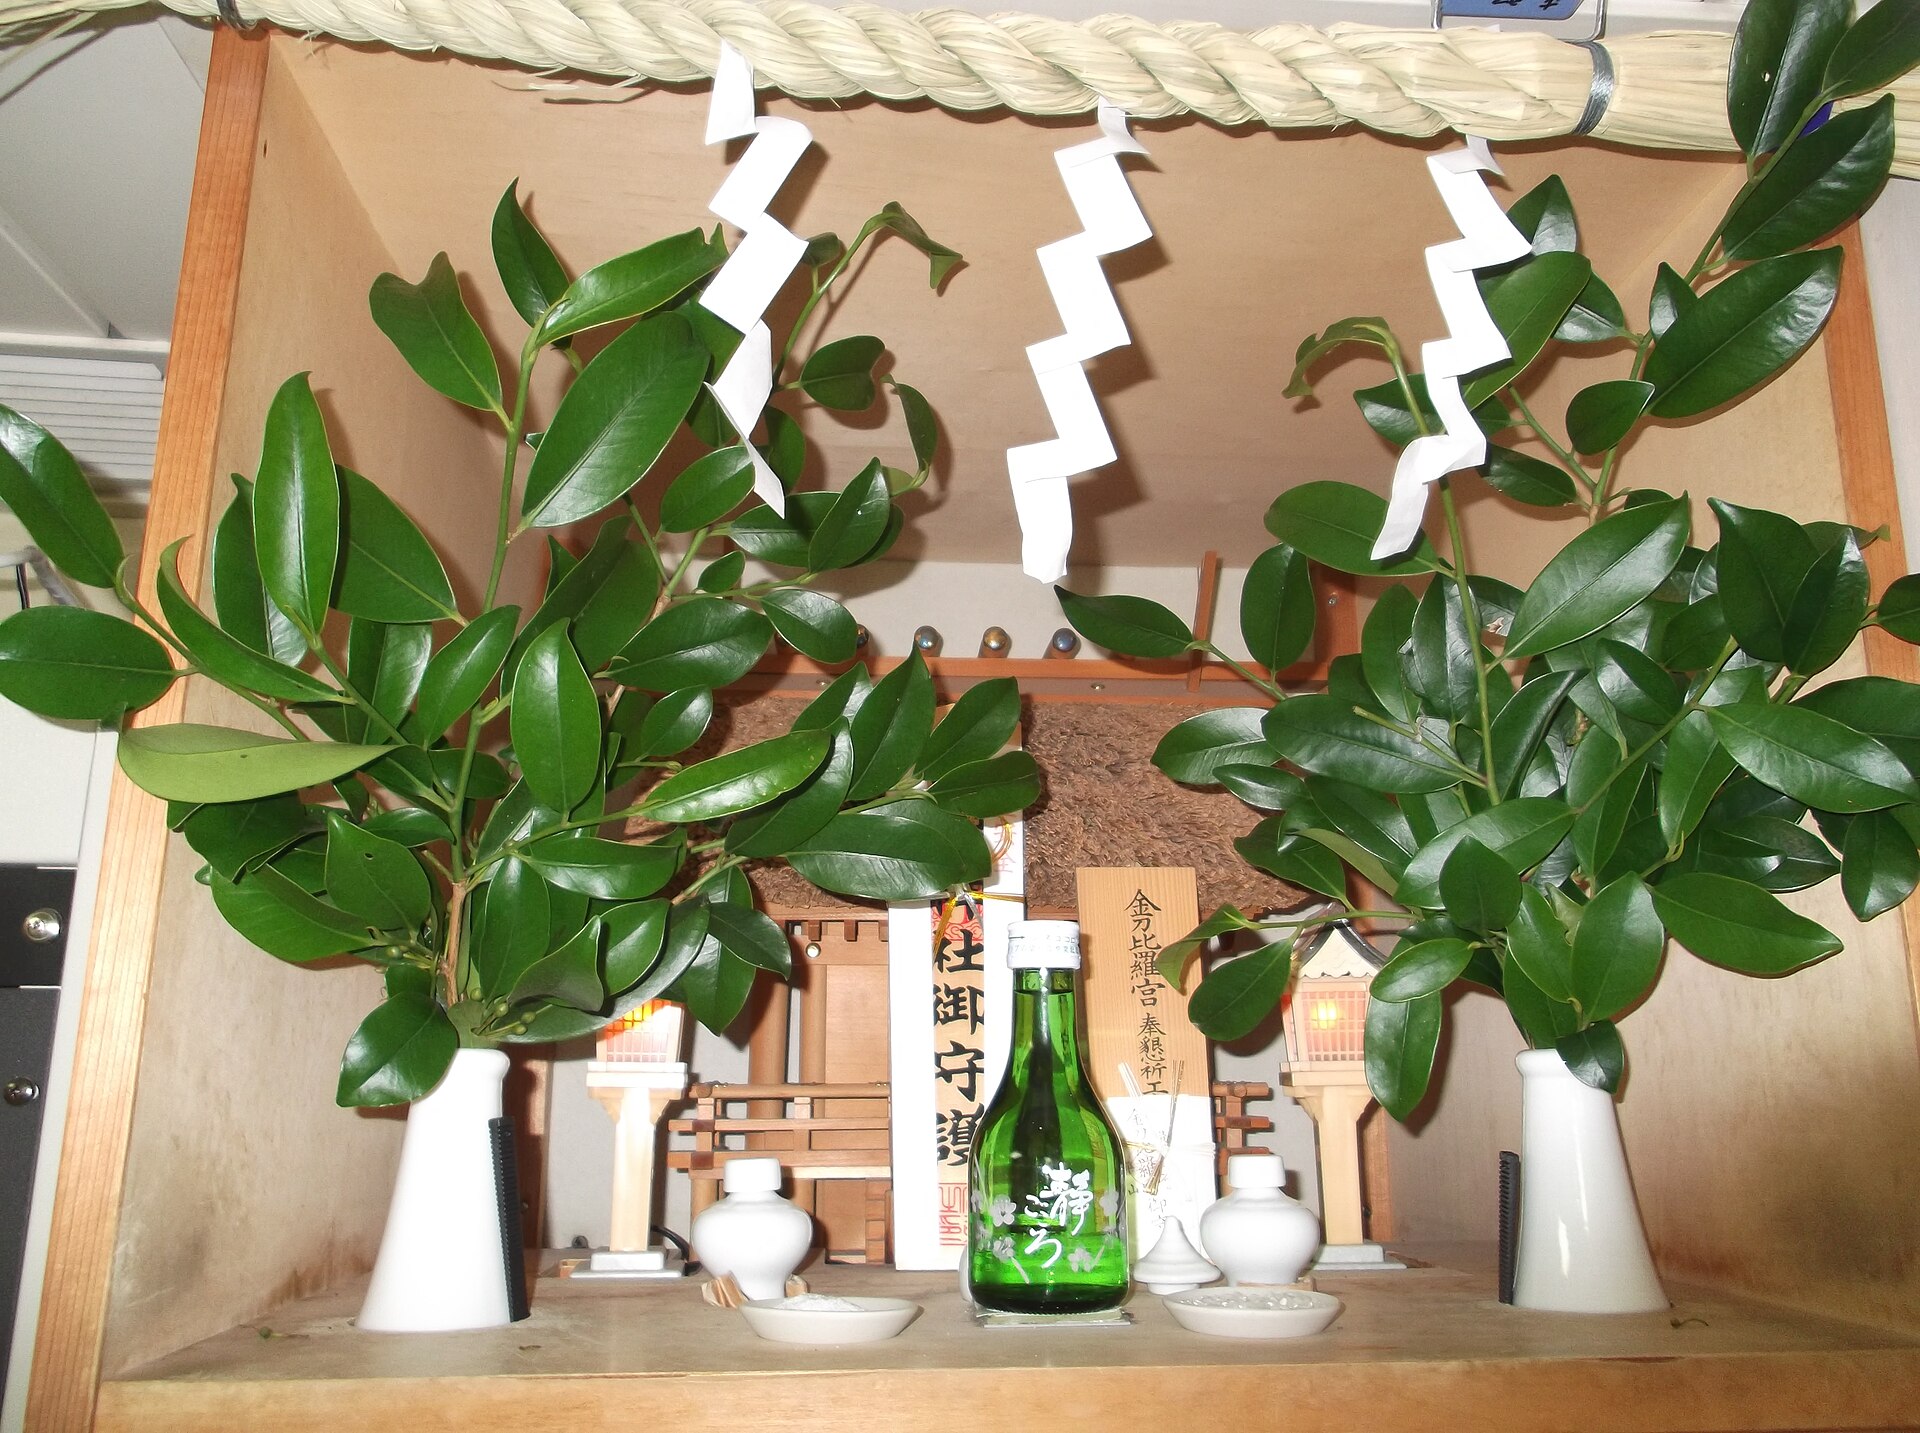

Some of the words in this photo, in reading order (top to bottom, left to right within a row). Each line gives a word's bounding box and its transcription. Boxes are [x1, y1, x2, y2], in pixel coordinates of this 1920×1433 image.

[1124, 888, 1166, 1007] 金刀比羅宮
[931, 898, 984, 1167] 社御守護
[1137, 1013, 1169, 1095] 奉懇祈工
